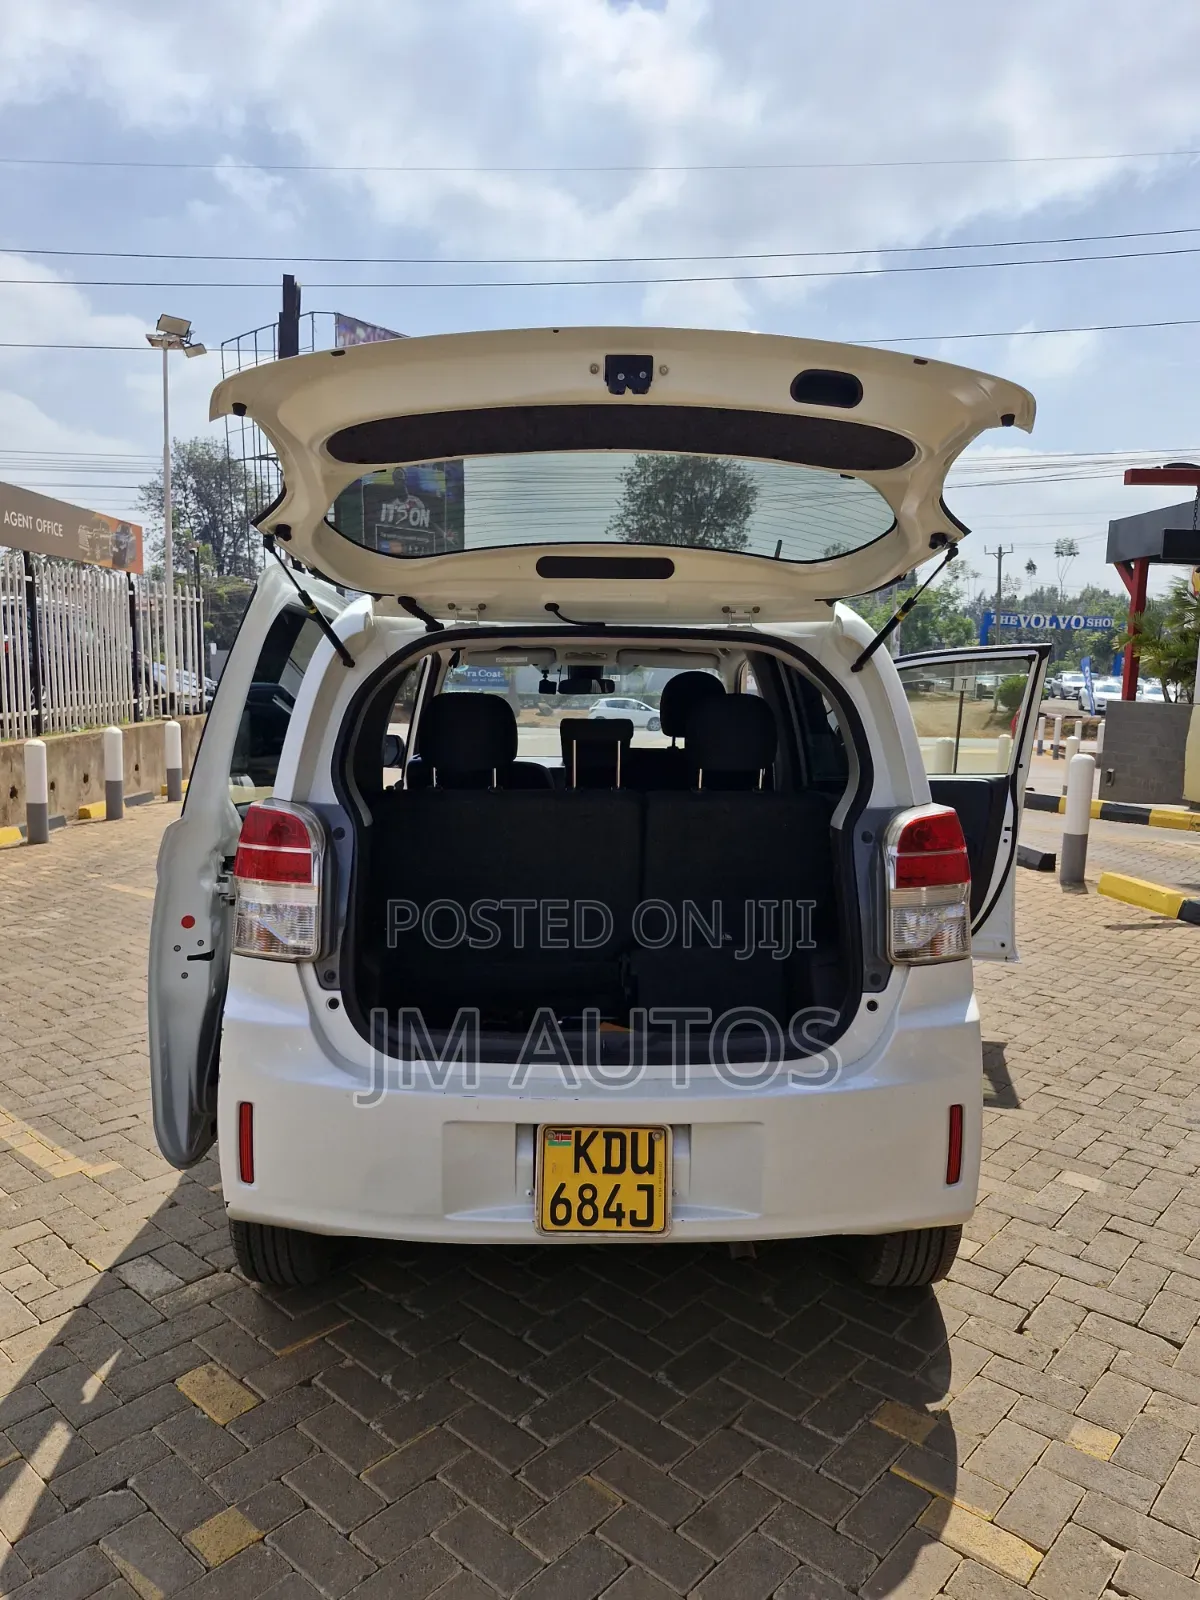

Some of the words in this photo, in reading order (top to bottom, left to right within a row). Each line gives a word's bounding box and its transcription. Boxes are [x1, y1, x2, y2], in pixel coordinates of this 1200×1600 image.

[4, 510, 33, 530] AGENT
[36, 518, 63, 537] OFFICE
[409, 507, 431, 528] ON
[991, 614, 1018, 626] THE
[1018, 614, 1084, 629] VOLVO
[574, 1130, 655, 1175] KDU
[549, 1182, 655, 1228] 684J
